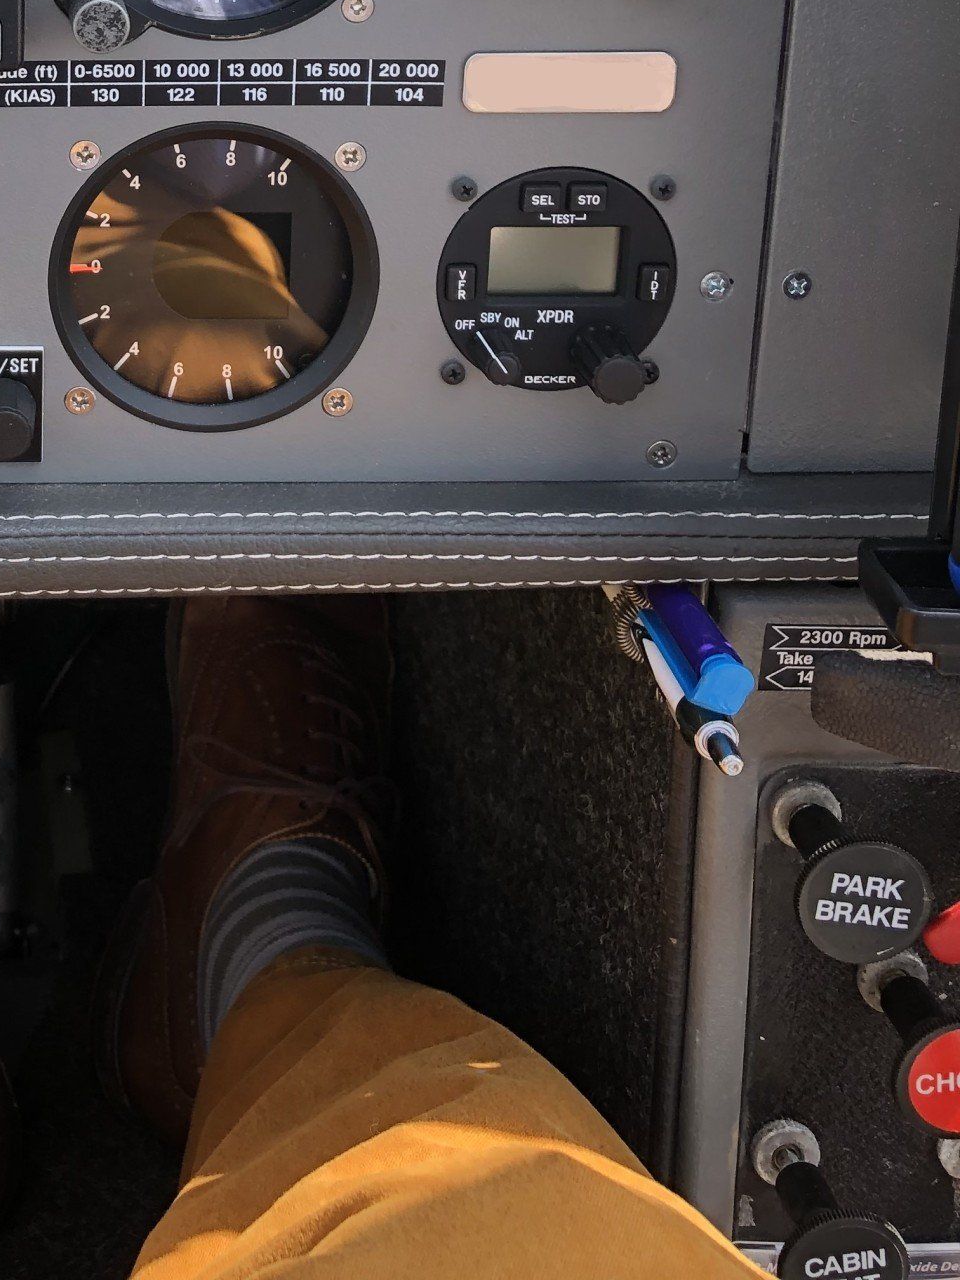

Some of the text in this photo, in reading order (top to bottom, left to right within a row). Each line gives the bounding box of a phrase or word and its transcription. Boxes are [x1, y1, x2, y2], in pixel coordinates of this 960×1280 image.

[35, 64, 58, 81] (ft)
[74, 63, 136, 78] 0-6500
[153, 64, 172, 78] 10
[178, 63, 210, 78] 000
[227, 63, 245, 77] 13
[250, 63, 283, 77] 000
[304, 63, 323, 77] 16
[328, 63, 361, 77] 500
[379, 63, 401, 78] 20
[406, 63, 439, 78] 000
[4, 88, 56, 105] (KIAS)
[91, 88, 120, 102] 130
[167, 88, 195, 102] 122
[242, 88, 268, 102] 116
[319, 88, 345, 101] 110
[395, 88, 424, 102] 104
[175, 155, 187, 169] 6
[225, 152, 236, 167] 8
[129, 176, 141, 190] 4
[268, 172, 288, 186] 10
[531, 196, 555, 206] SEL
[578, 195, 601, 206] STO
[99, 213, 111, 228] 2
[551, 214, 576, 224] TEST
[91, 259, 101, 274] 0
[99, 305, 111, 319] 2
[480, 312, 502, 323] SBY
[537, 310, 574, 324] XPDR
[455, 320, 476, 330] OFF
[504, 317, 520, 328] ON
[514, 329, 535, 340] ALT
[129, 341, 140, 356] 4
[264, 345, 283, 359] 10
[174, 362, 184, 376] 6
[222, 364, 232, 378] 8
[524, 375, 576, 384] BECKER
[800, 631, 887, 648] 2300 Rpm
[777, 651, 814, 665] Take
[830, 872, 906, 901] PARK
[815, 899, 911, 930] BRAKE
[804, 1248, 887, 1278] CABIN
